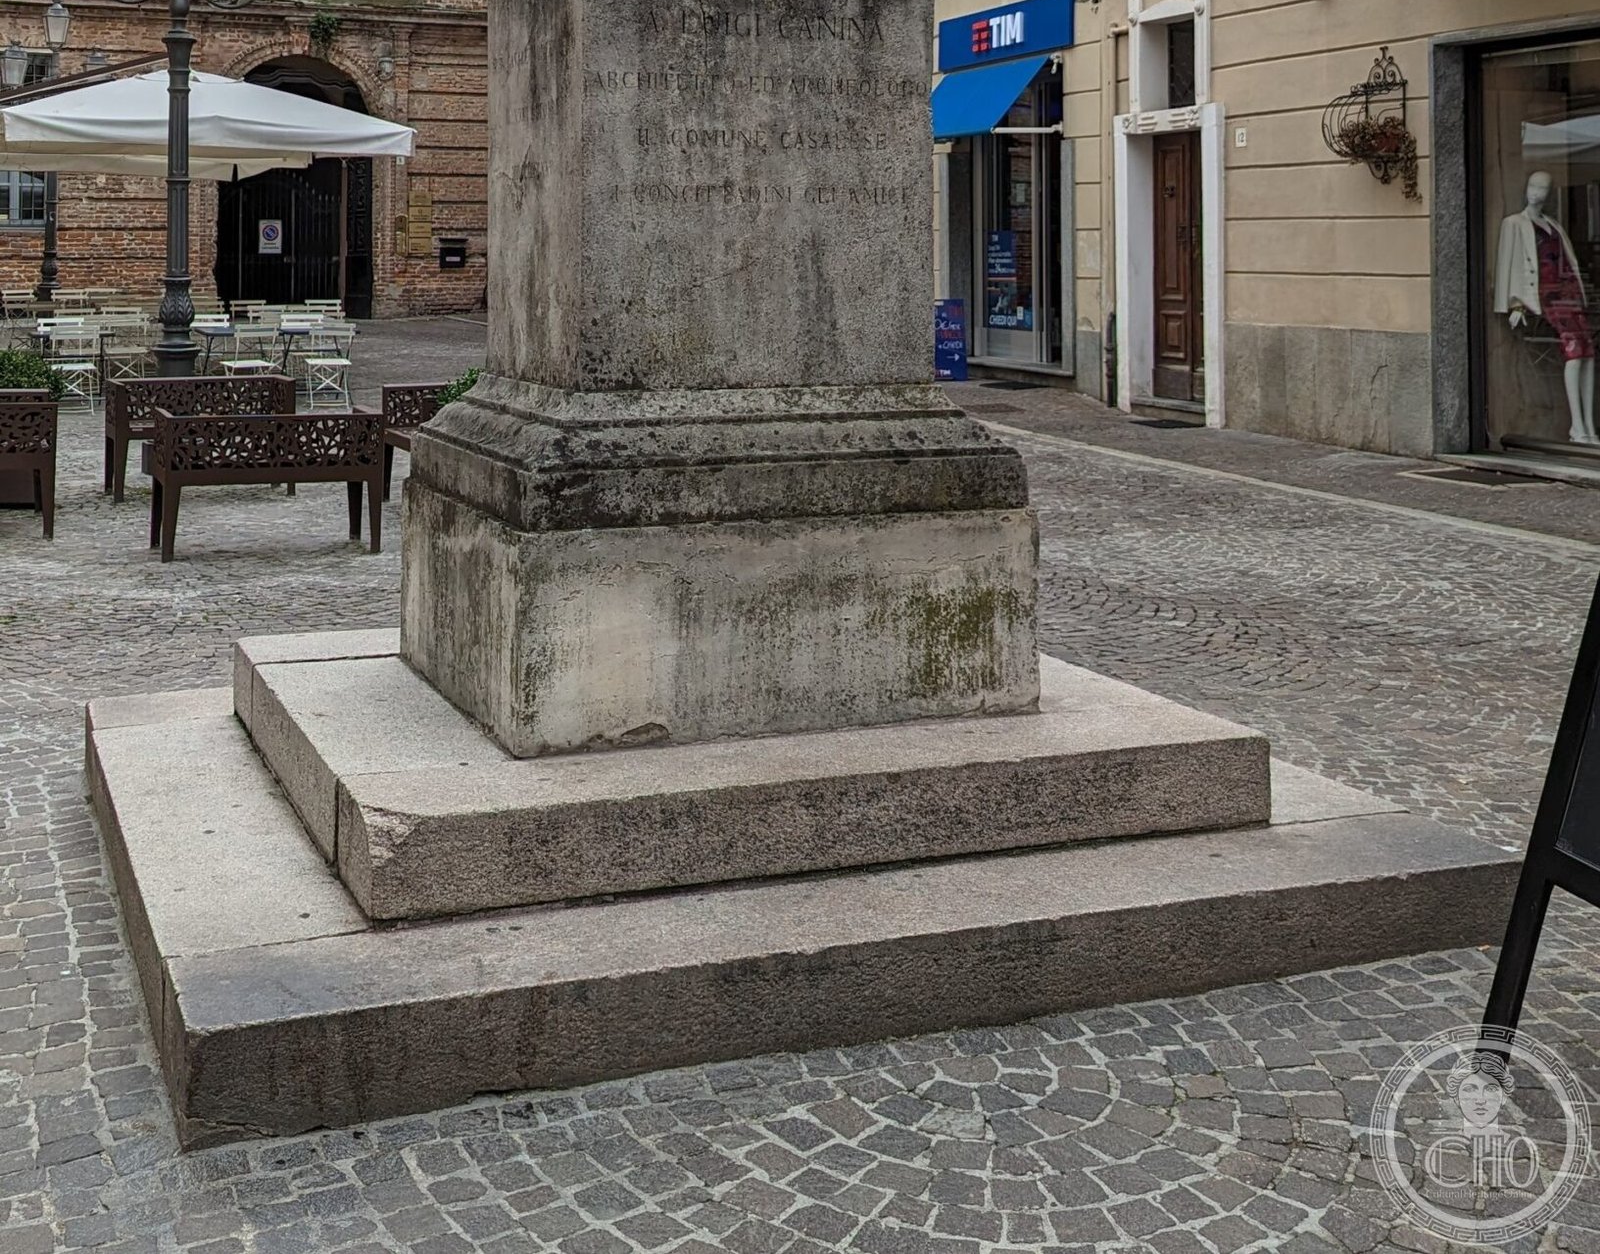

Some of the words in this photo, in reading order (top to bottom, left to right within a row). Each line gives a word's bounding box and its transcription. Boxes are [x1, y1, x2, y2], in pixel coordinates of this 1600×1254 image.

[681, 9, 765, 38] LUIGI
[777, 12, 884, 42] CANINA
[989, 11, 1024, 49] TIM
[592, 70, 736, 92] ARCHITETTO
[749, 75, 775, 93] ED
[670, 128, 768, 148] COMUNE
[780, 131, 887, 150] CASALESE
[633, 183, 792, 204] CONCITTADINI
[848, 186, 911, 206] AMICI
